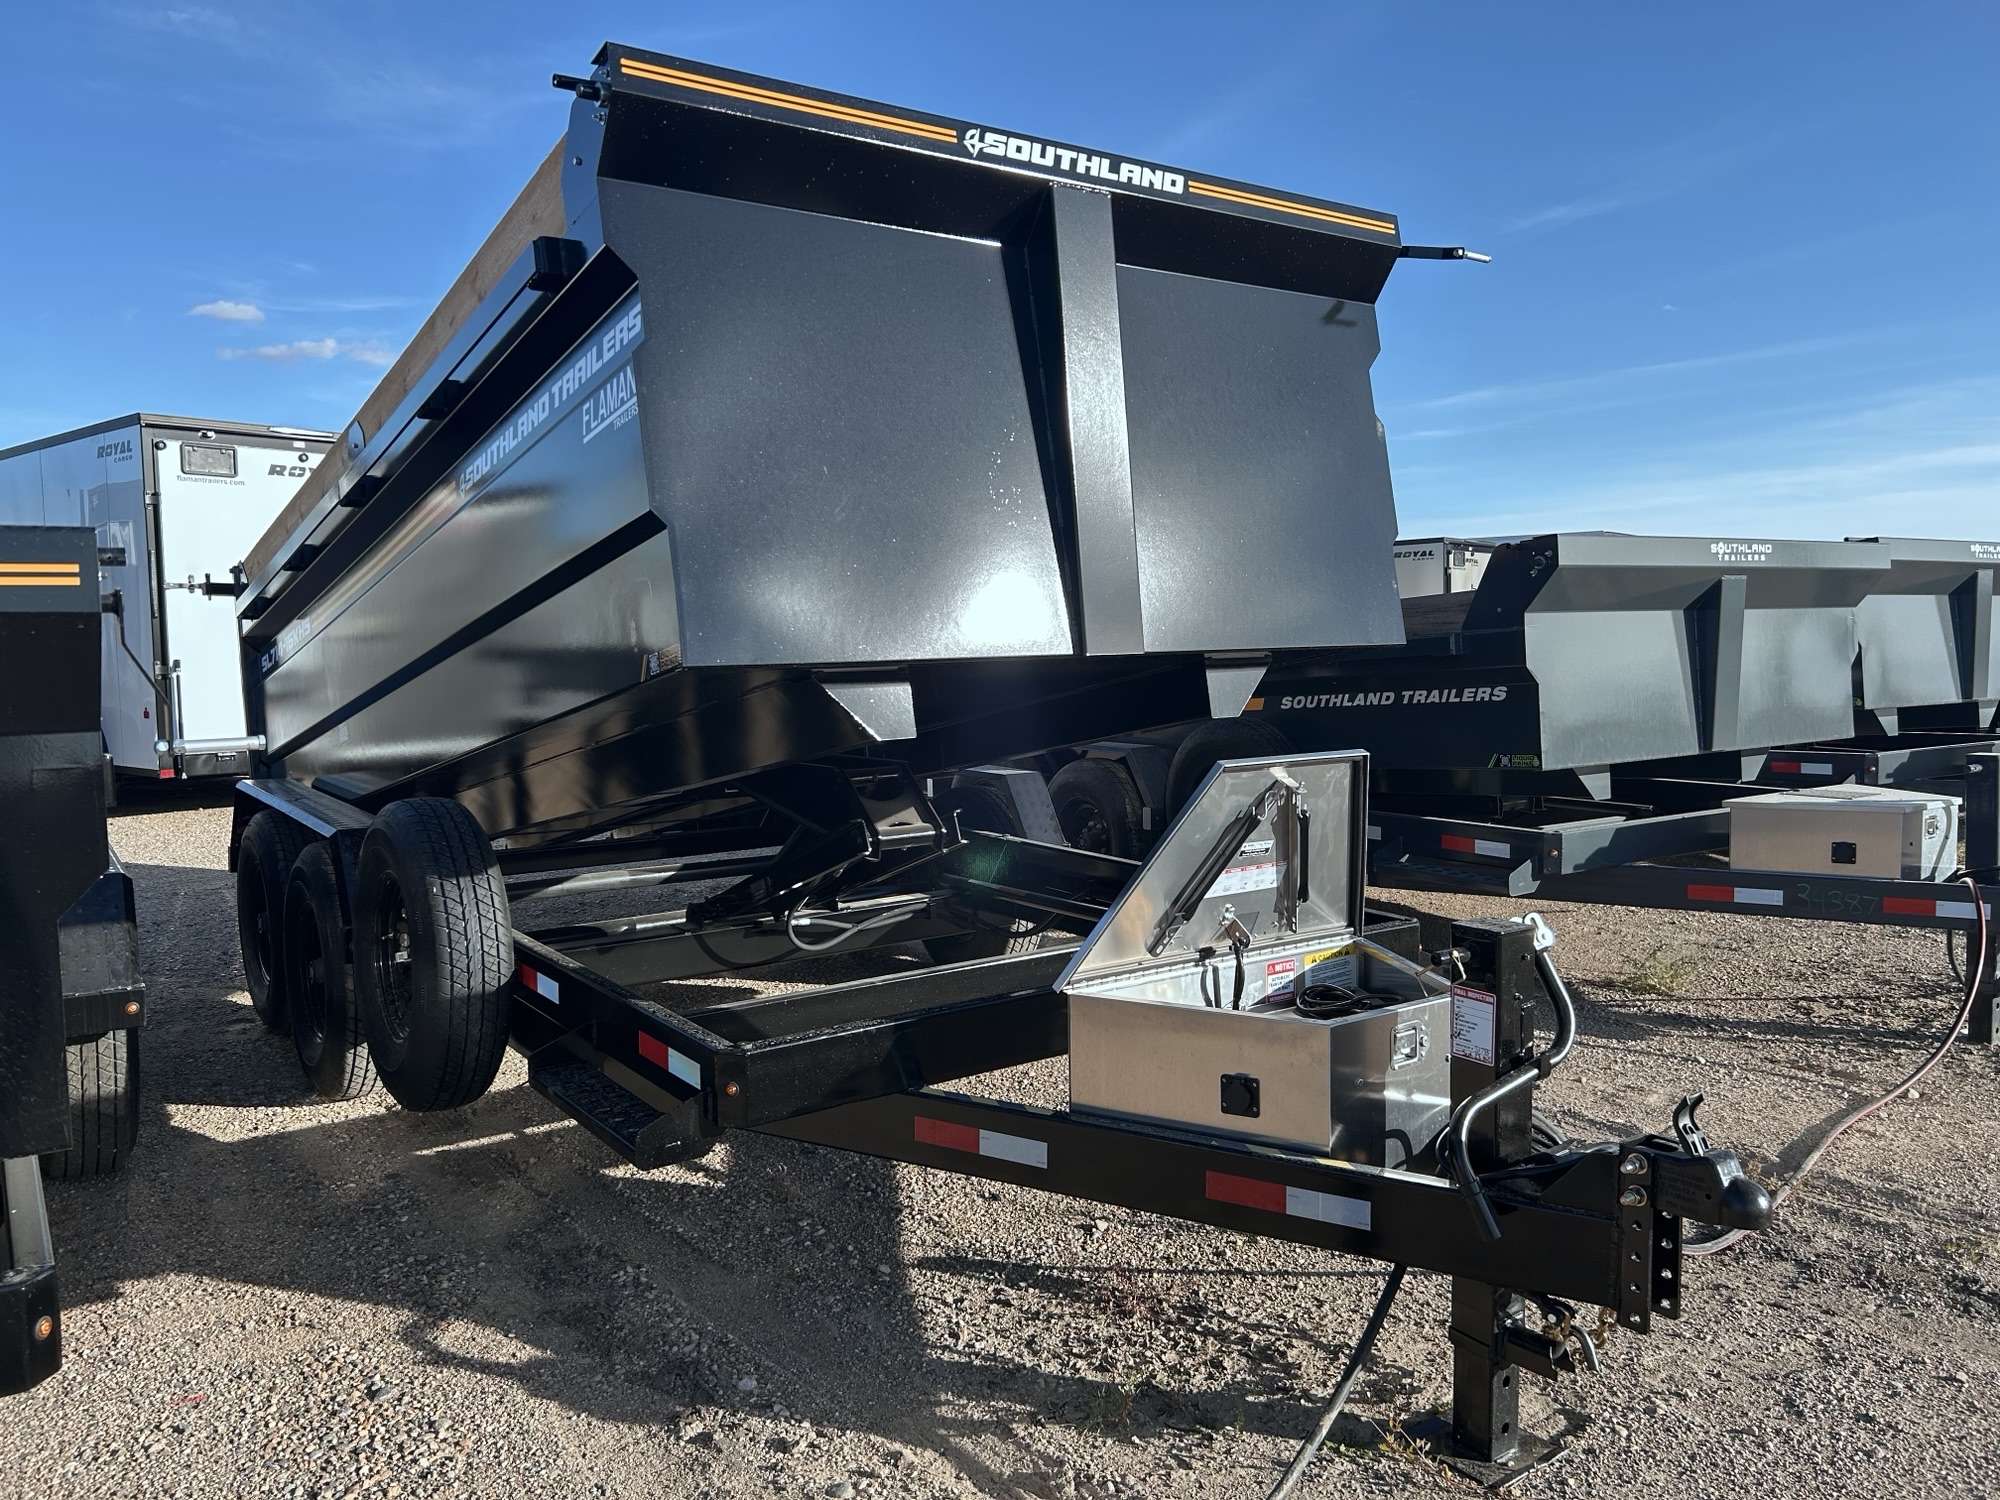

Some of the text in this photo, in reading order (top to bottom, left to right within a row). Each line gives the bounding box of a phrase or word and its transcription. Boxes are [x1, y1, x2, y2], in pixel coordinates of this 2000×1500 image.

[983, 131, 1185, 195] SOUTHLAND
[464, 302, 642, 491] SOUTHLAND TRAILERS
[582, 365, 637, 436] FLAMAN
[614, 405, 639, 431] TRAILERS
[97, 440, 132, 459] ROYAL
[1710, 542, 1772, 554] SOUTHLAND
[1280, 686, 1508, 710] SOUTHLAND TRAILERS
[1275, 961, 1294, 972] NOTICE
